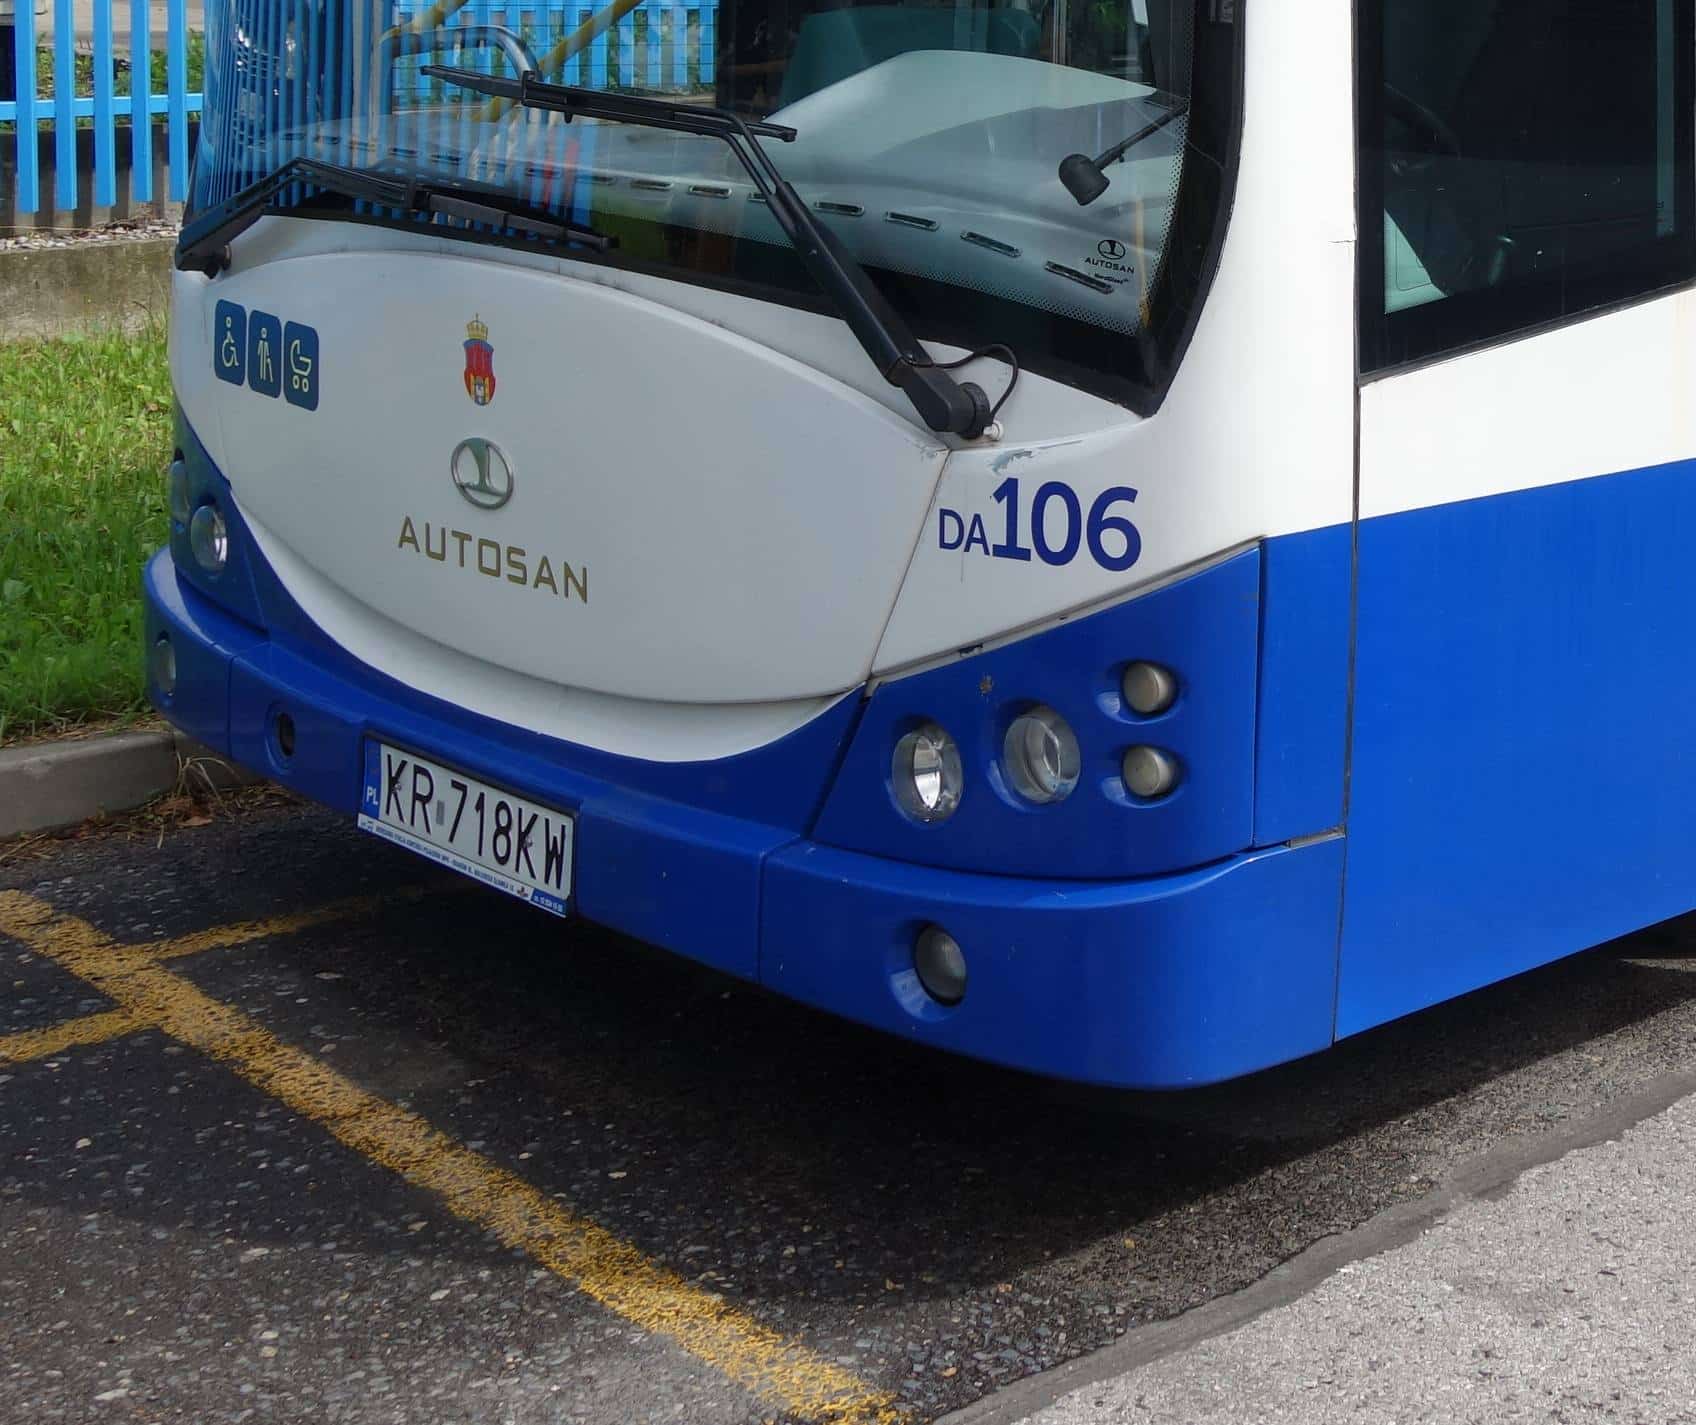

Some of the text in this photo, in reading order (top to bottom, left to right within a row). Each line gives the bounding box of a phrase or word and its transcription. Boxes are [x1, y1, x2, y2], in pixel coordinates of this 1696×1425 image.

[1084, 257, 1135, 274] AUTOSAN
[398, 514, 588, 604] AUTOSAN
[366, 786, 379, 806] PL
[385, 753, 432, 835] KR
[448, 779, 567, 890] 718KW
